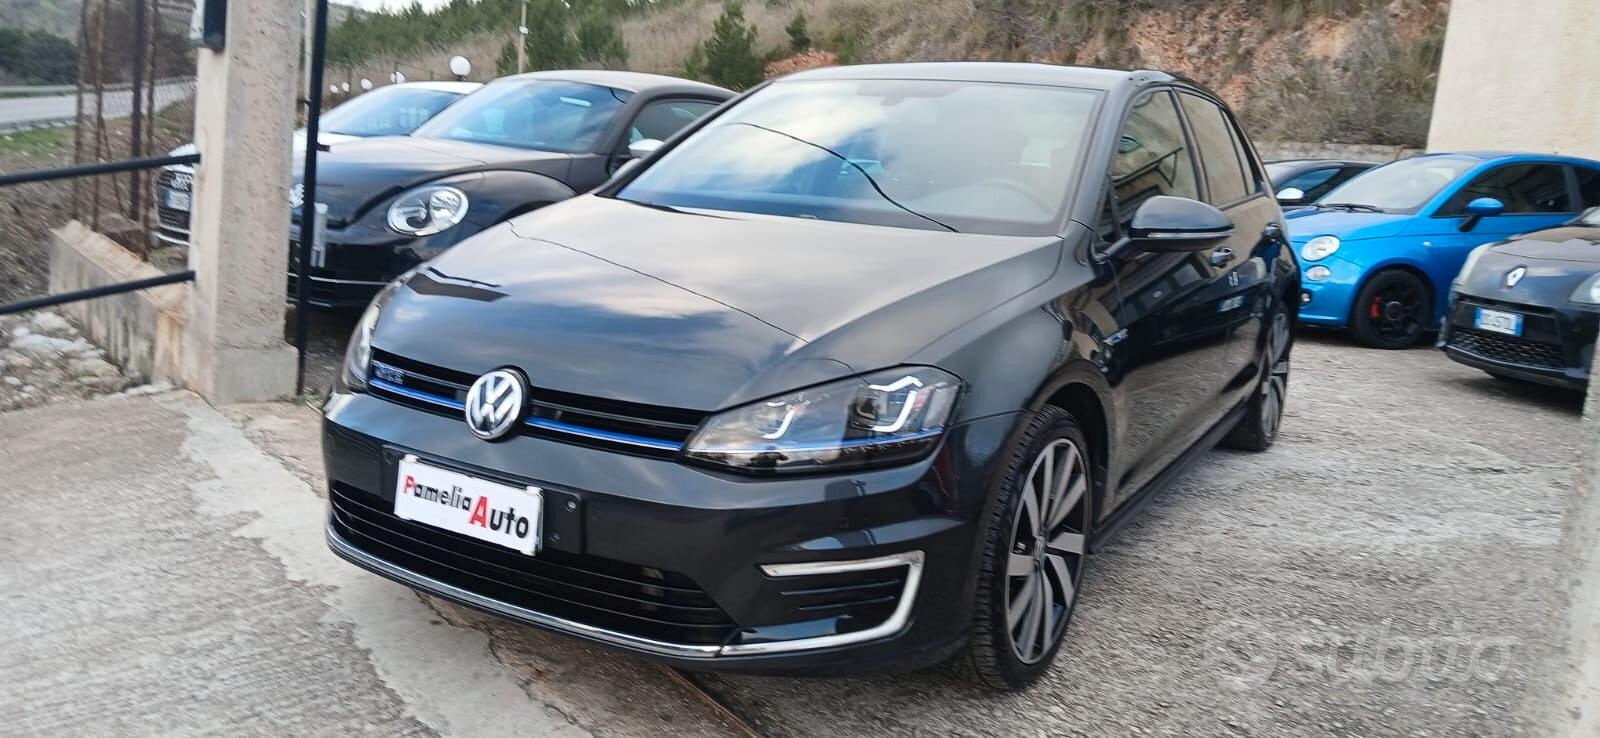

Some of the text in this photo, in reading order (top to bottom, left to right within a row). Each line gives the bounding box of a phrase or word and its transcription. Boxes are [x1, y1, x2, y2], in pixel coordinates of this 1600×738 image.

[467, 373, 520, 433] VW
[403, 475, 529, 538] Pamelia Auto
